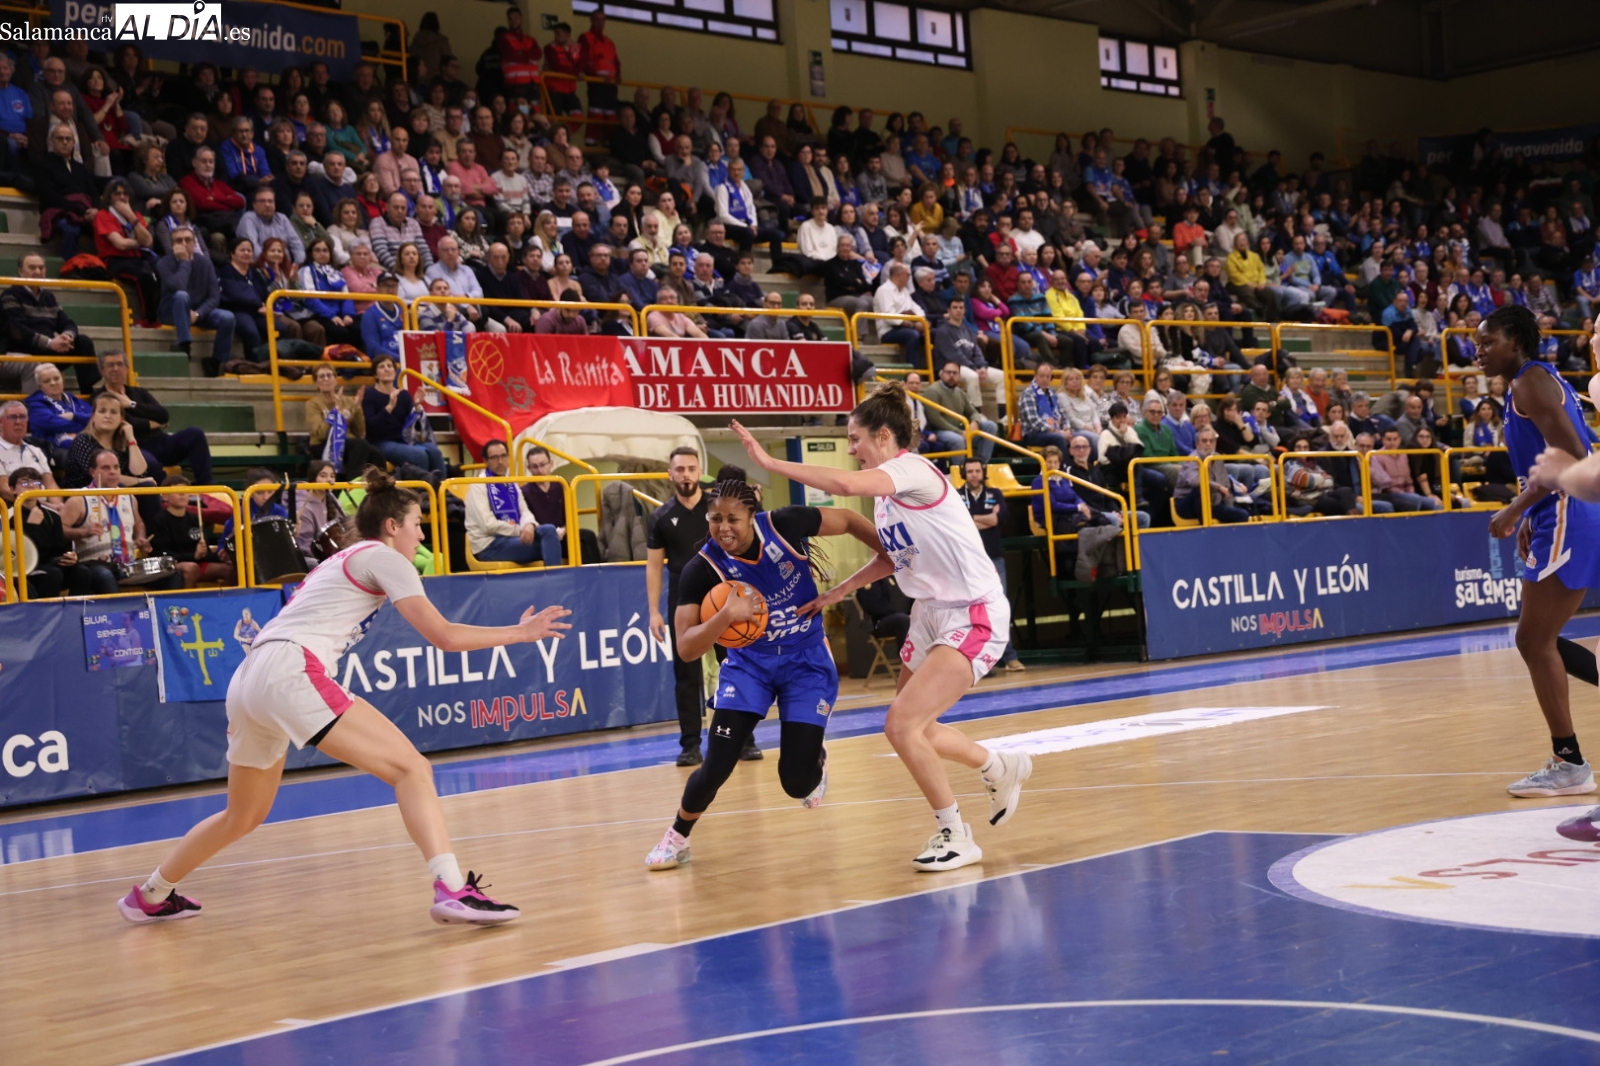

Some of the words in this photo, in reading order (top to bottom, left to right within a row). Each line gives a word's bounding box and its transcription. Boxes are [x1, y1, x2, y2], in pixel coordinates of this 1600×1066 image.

[532, 350, 556, 385] La
[557, 351, 625, 386] Ranita
[637, 383, 671, 408] DE
[677, 383, 707, 408] LA
[712, 383, 843, 408] HUMANIDAD
[1172, 571, 1284, 609] CASTILLA
[1293, 567, 1308, 604] Y
[1315, 553, 1369, 595] LEÓN
[96, 627, 127, 639] SIEMPRE
[1231, 614, 1257, 634] NOS
[1259, 607, 1324, 639] IMPULSA
[113, 647, 144, 658] CONTIGO
[342, 644, 517, 693] ASTILLA
[535, 636, 560, 684] Y
[578, 611, 674, 671] LEÓN
[417, 700, 467, 728] NOS
[471, 687, 588, 732] IMPULSA
